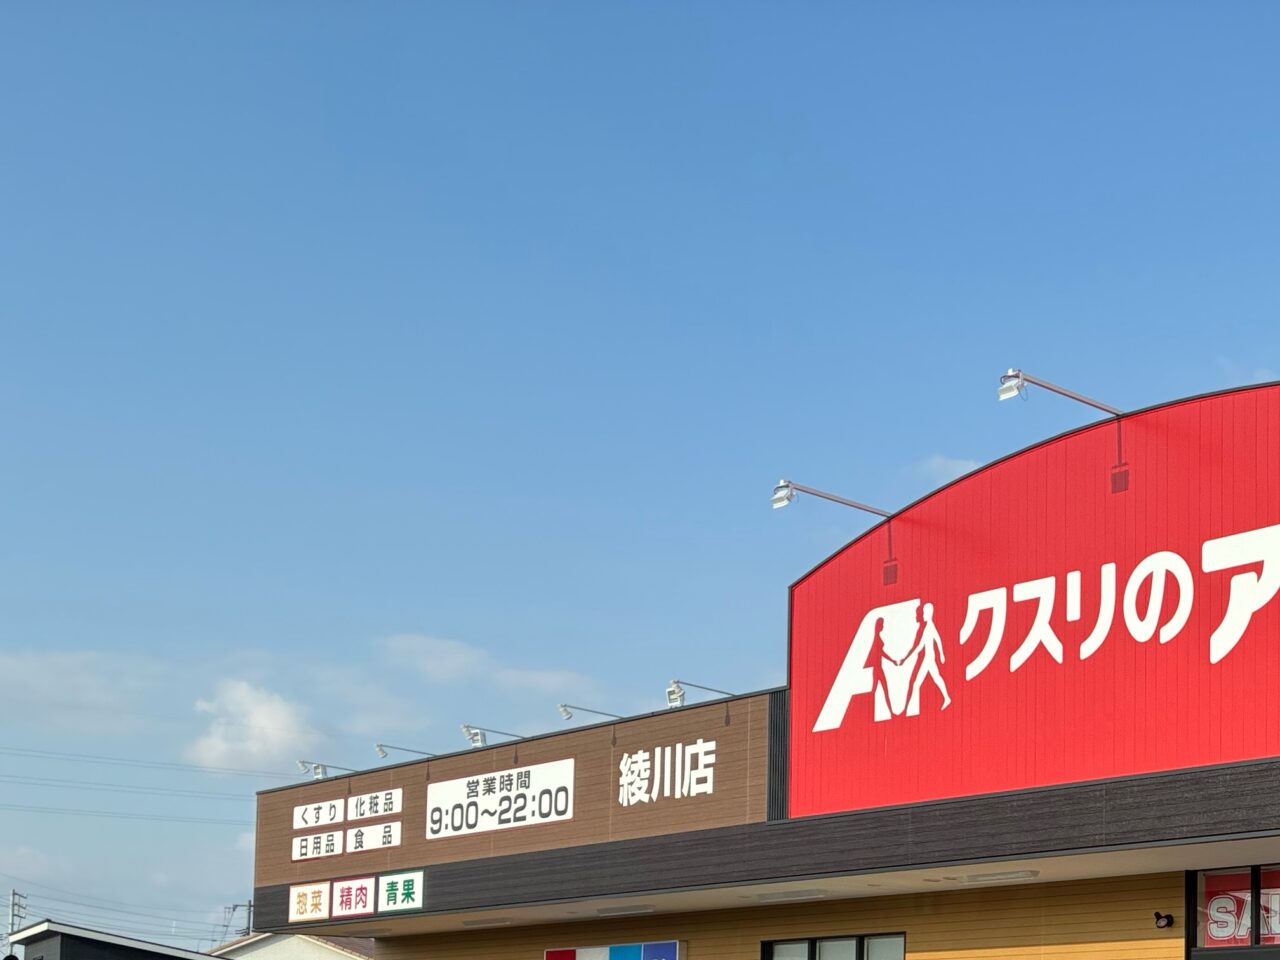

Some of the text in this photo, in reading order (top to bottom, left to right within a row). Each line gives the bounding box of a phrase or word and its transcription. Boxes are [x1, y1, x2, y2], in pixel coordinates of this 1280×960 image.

[466, 770, 532, 799] 営業時間
[618, 740, 716, 807] 綾川店
[301, 803, 337, 824] くすり
[355, 792, 394, 818] 化粧品
[299, 834, 335, 857] 日用品
[296, 890, 322, 915] 惣菜
[340, 884, 368, 910] 精肉
[386, 879, 416, 906] 青果
